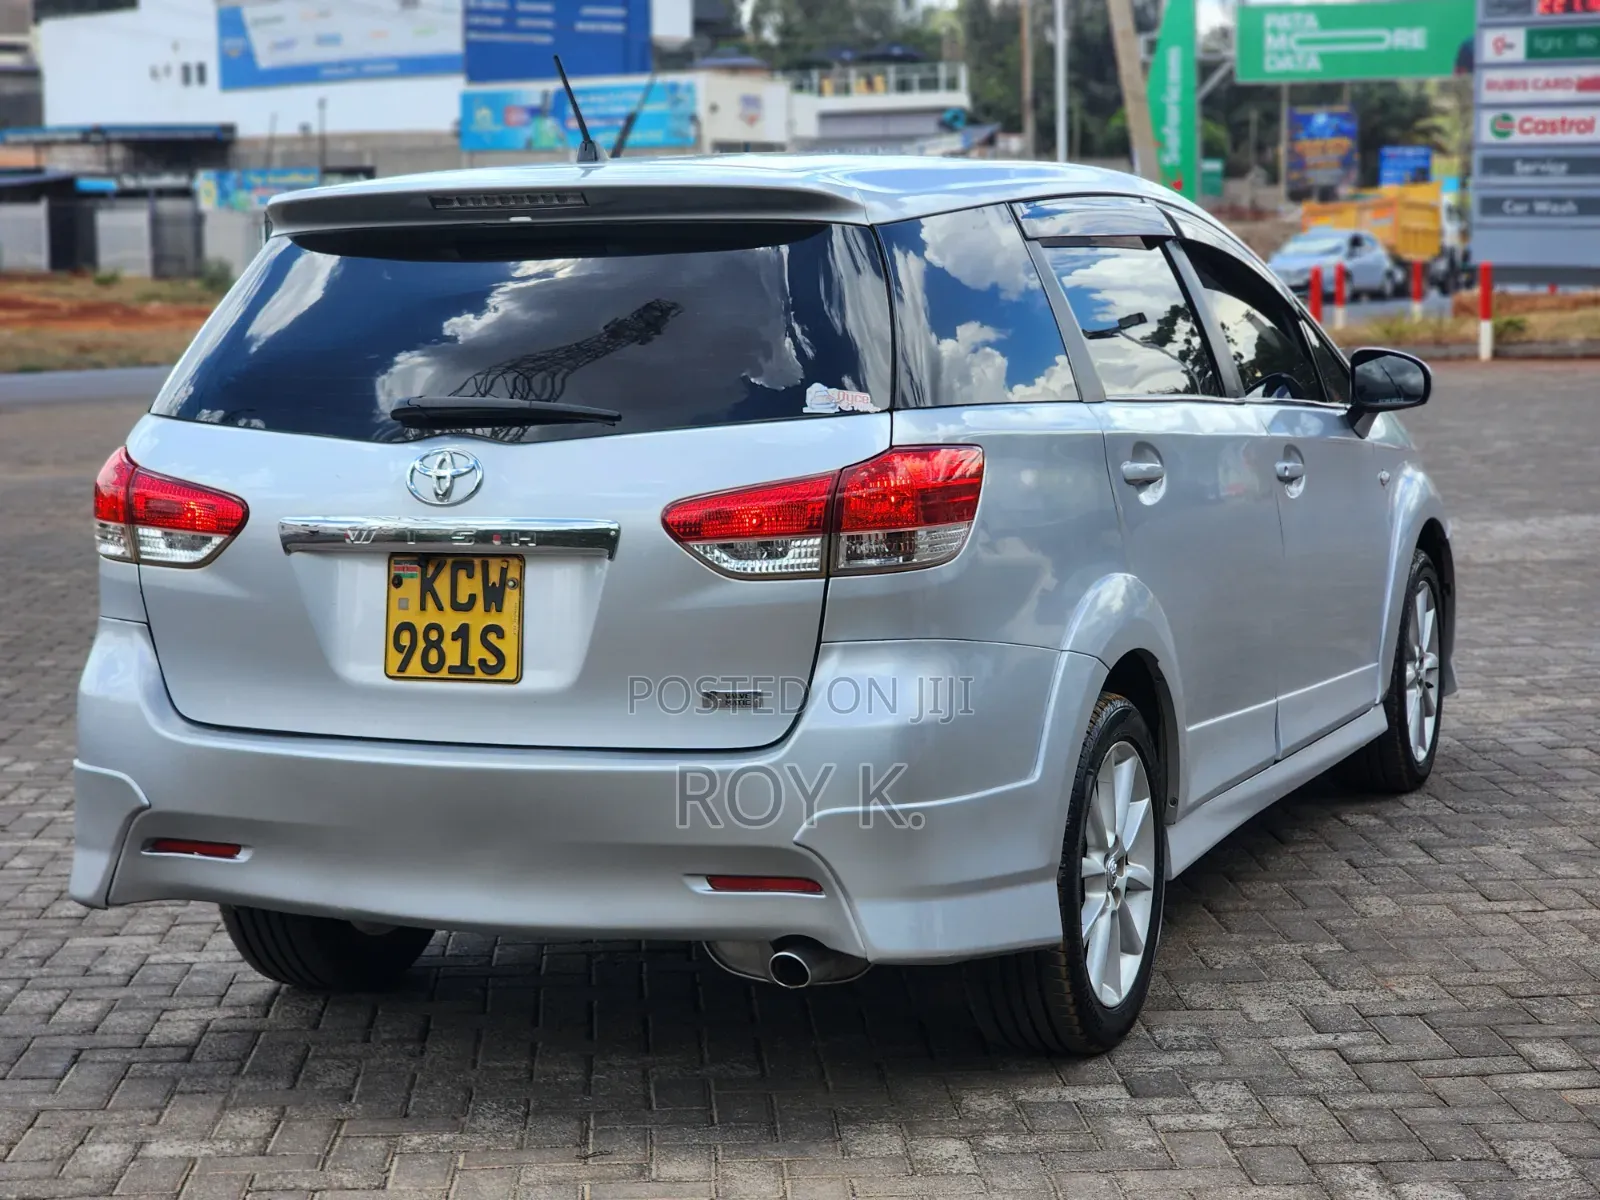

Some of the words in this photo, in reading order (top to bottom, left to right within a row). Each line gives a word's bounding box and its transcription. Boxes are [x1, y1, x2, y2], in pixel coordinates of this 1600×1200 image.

[1263, 52, 1322, 73] DATA
[1518, 115, 1597, 136] Castrol
[1514, 159, 1569, 176] Service
[1501, 199, 1530, 215] Car
[1532, 198, 1579, 215] Wash
[419, 559, 510, 613] KCW
[392, 620, 506, 676] 981S
